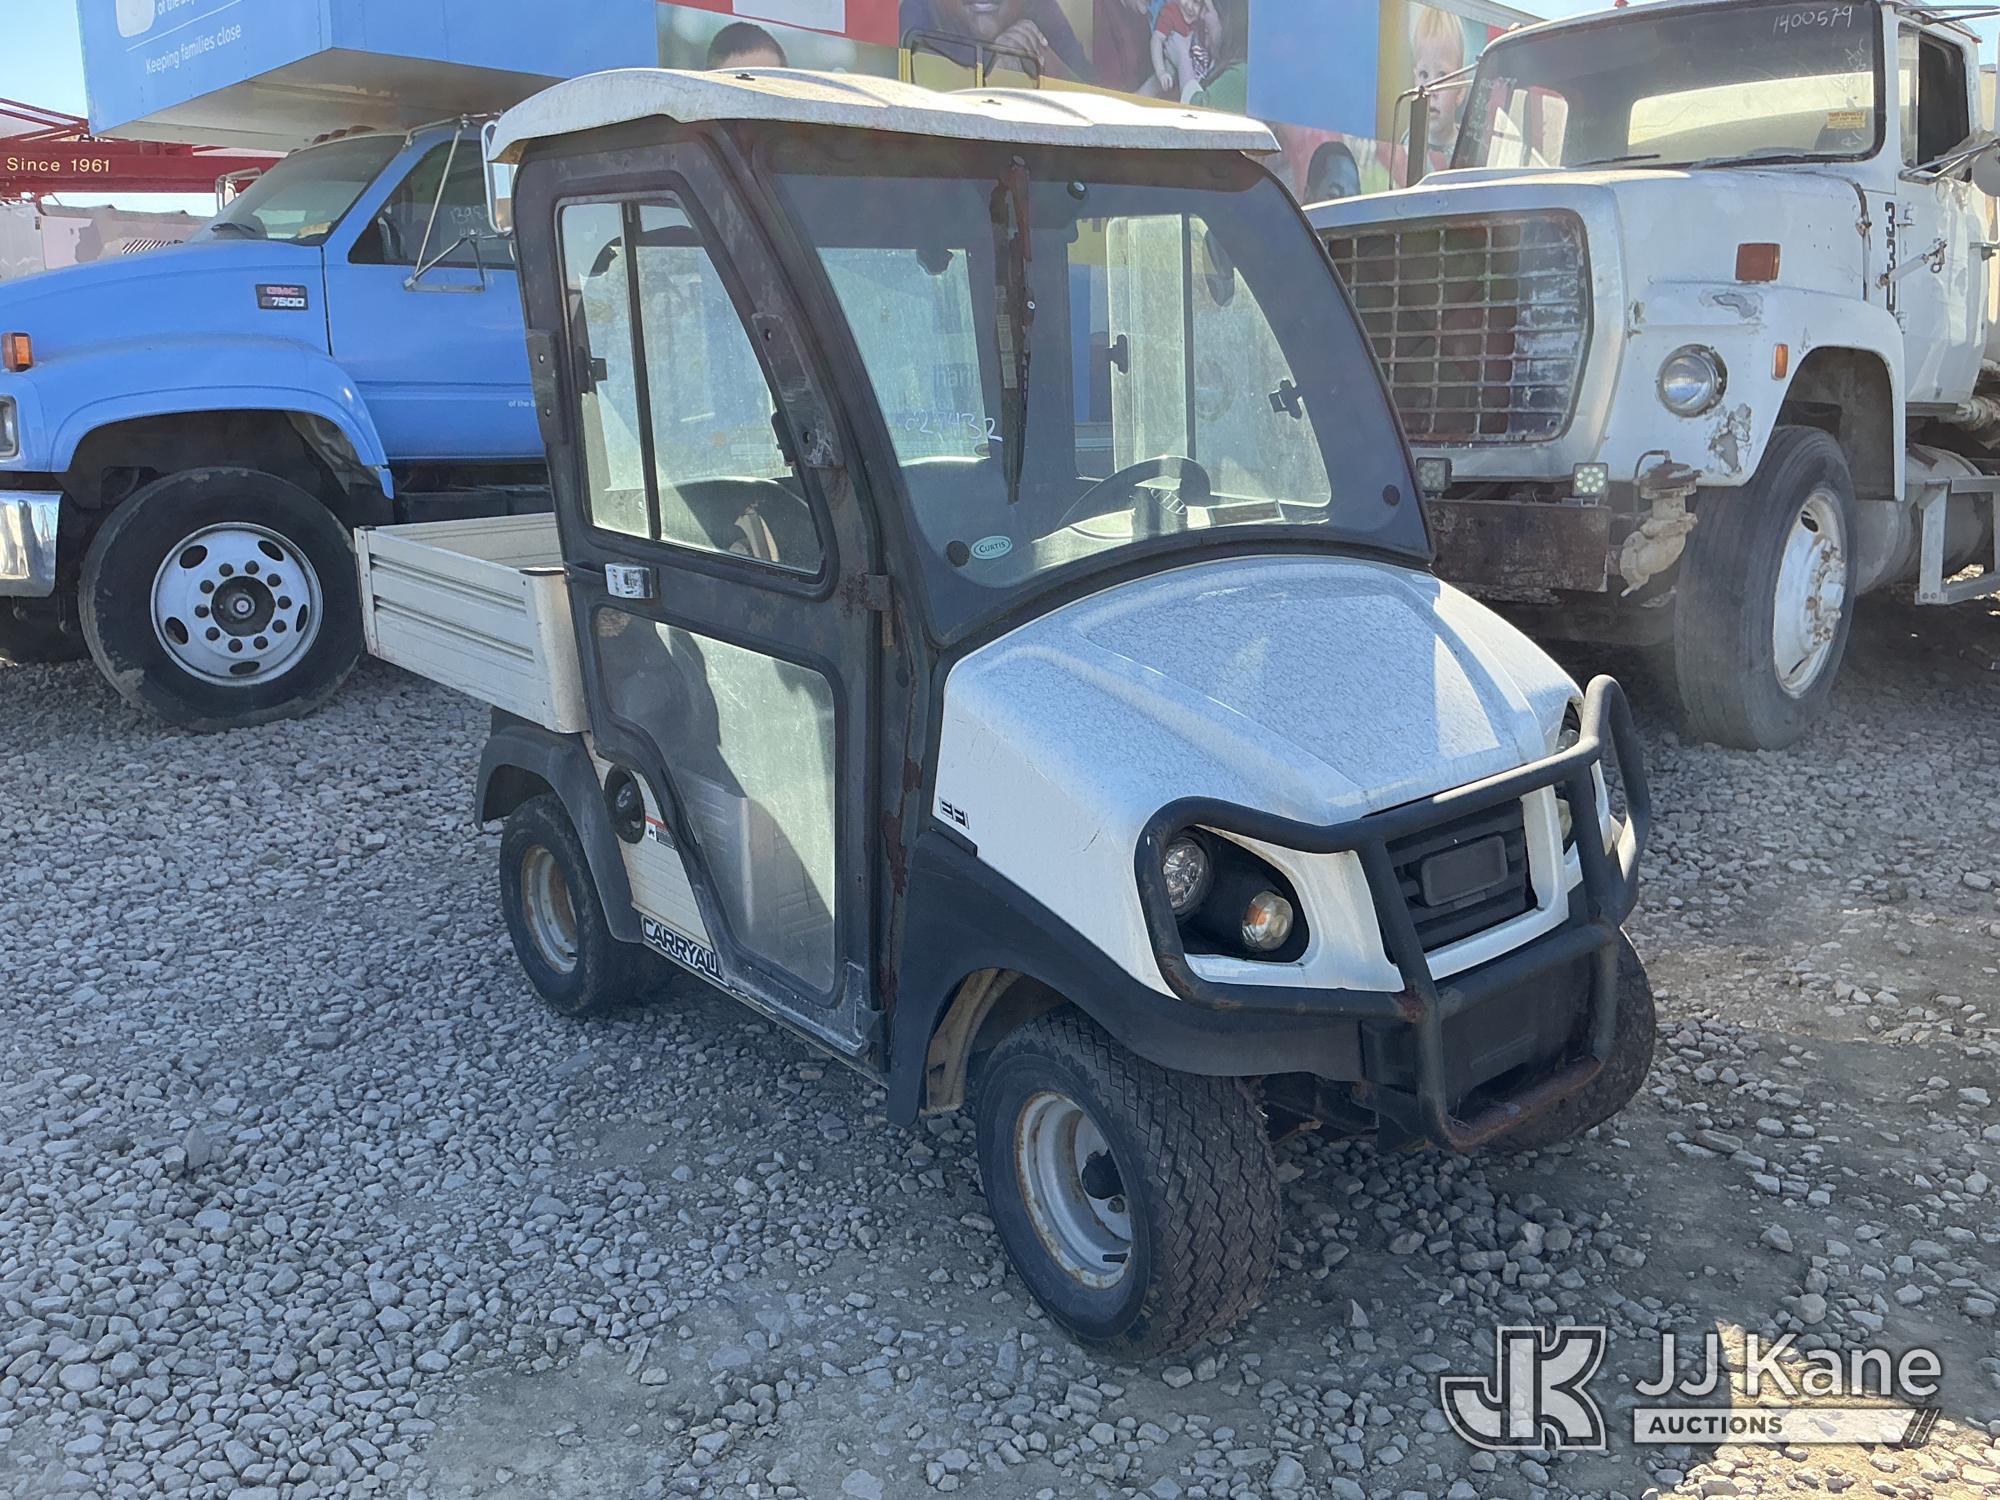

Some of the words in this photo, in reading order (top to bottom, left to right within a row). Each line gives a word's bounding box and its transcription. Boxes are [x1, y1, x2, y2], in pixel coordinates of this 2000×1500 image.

[1773, 5, 1852, 33] 1400579
[145, 51, 180, 74] Keeping
[180, 34, 215, 60] families
[216, 23, 242, 46] close
[7, 157, 60, 171] Since
[71, 159, 110, 172] 1961
[266, 286, 299, 296] GMC
